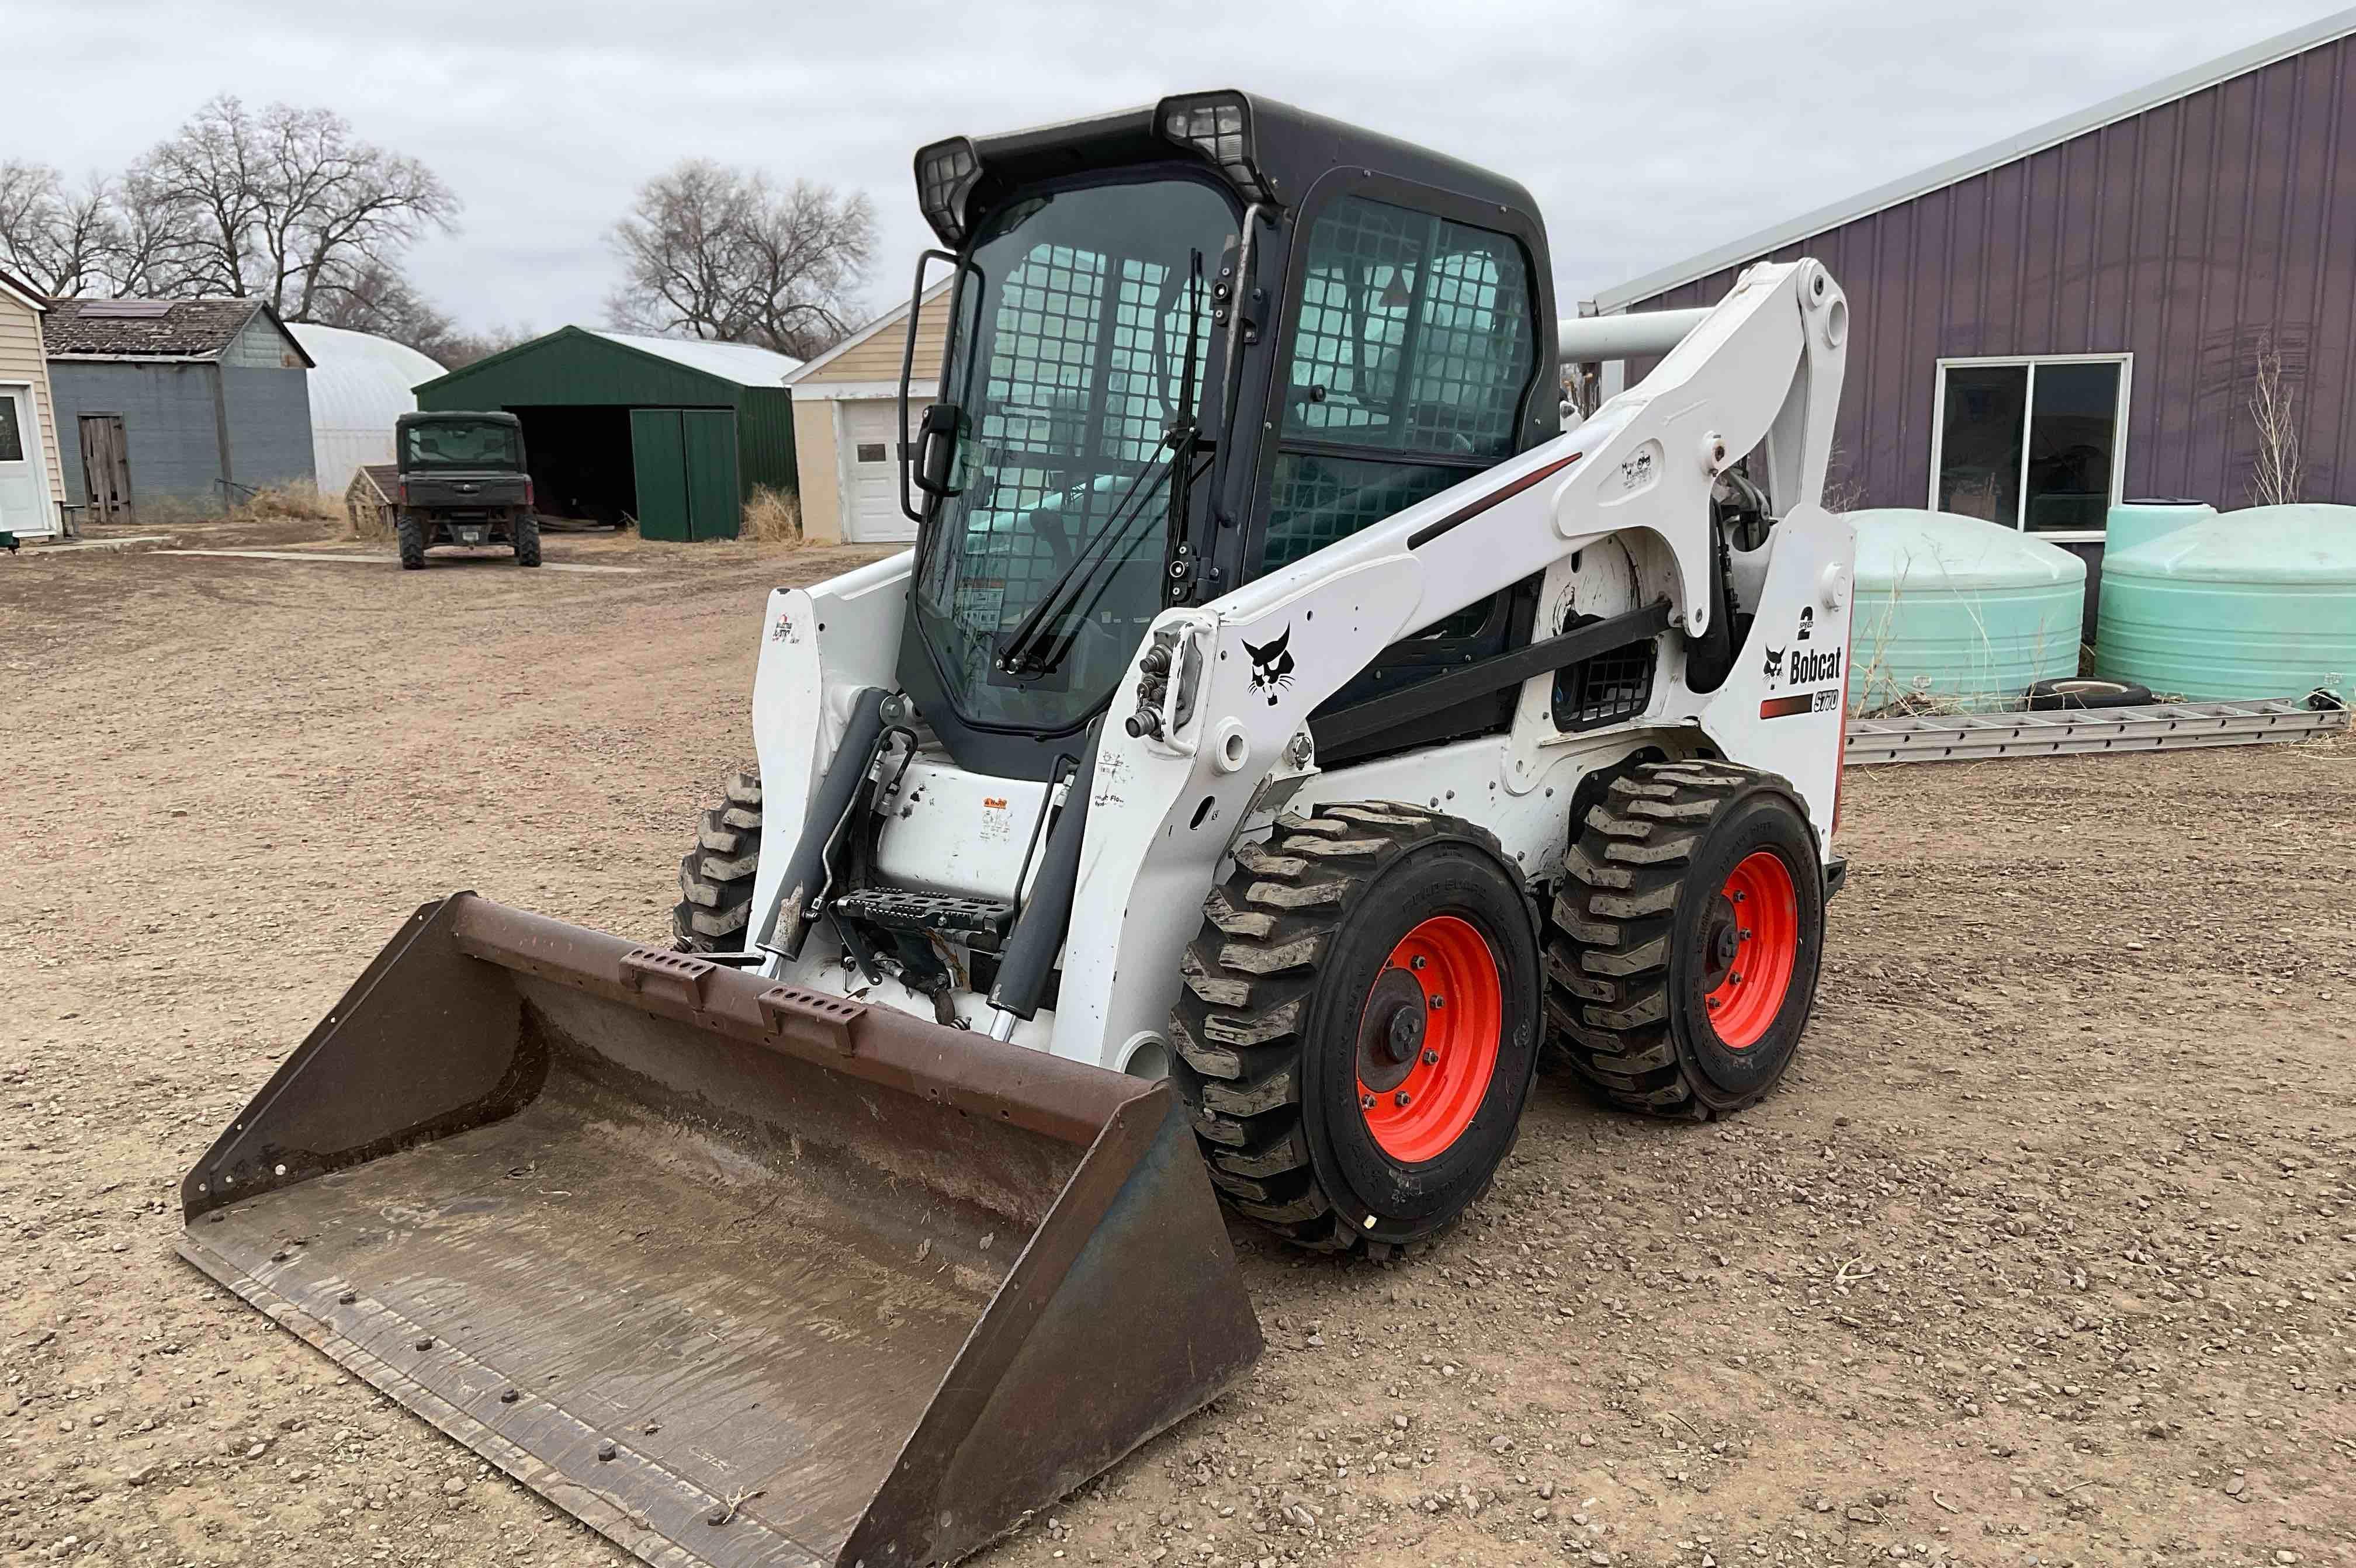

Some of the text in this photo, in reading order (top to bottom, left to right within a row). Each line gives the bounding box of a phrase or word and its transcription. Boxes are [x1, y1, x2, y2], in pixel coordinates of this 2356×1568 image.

[1797, 606, 1813, 640] 2
[1799, 621, 1814, 629] SPEED
[1790, 646, 1841, 685] Bobcat
[1814, 689, 1838, 712] S770
